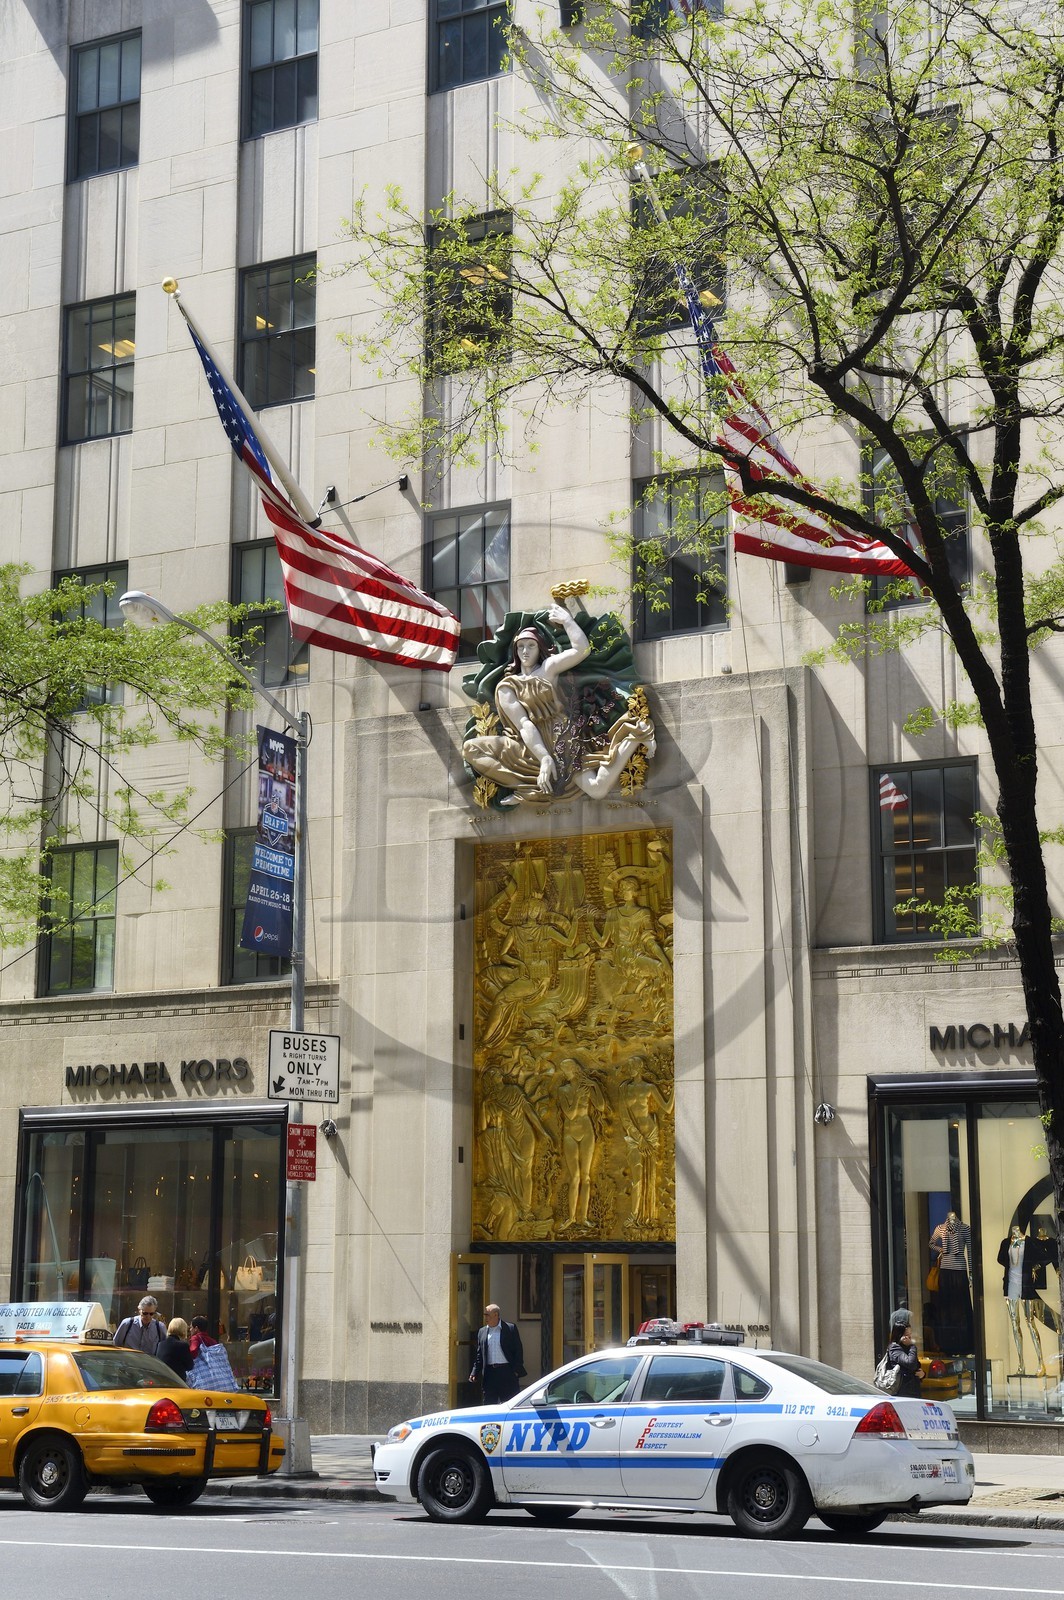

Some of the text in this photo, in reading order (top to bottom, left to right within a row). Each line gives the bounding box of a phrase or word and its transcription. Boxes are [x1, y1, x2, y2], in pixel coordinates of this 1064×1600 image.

[269, 738, 284, 755] NYC
[264, 814, 286, 831] DRAFT
[254, 847, 292, 867] WELCOME TO
[255, 858, 290, 877] PRIMETIME
[250, 884, 270, 898] APRIL
[263, 932, 278, 941] pepsi
[283, 1036, 327, 1053] BUSES
[66, 1057, 248, 1087] MICHAEL KORS
[287, 1061, 322, 1076] ONLY
[289, 1087, 304, 1096] MON
[324, 1090, 336, 1098] FRI
[302, 1128, 315, 1137] ROUTE
[288, 1149, 316, 1158] NO STANDING
[14, 1308, 44, 1316] SPOTTED
[44, 1307, 52, 1316] IN
[66, 1324, 78, 1332] Syfy
[370, 1322, 422, 1330] MICHAEL KORS
[92, 1330, 105, 1338] 5K51
[784, 1404, 797, 1414] 112
[800, 1404, 816, 1414] PCT
[826, 1406, 845, 1416] 3421
[922, 1406, 944, 1416] NYPD
[423, 1416, 450, 1428] POLICE
[922, 1420, 950, 1430] POLICE
[504, 1422, 590, 1452] NYPD
